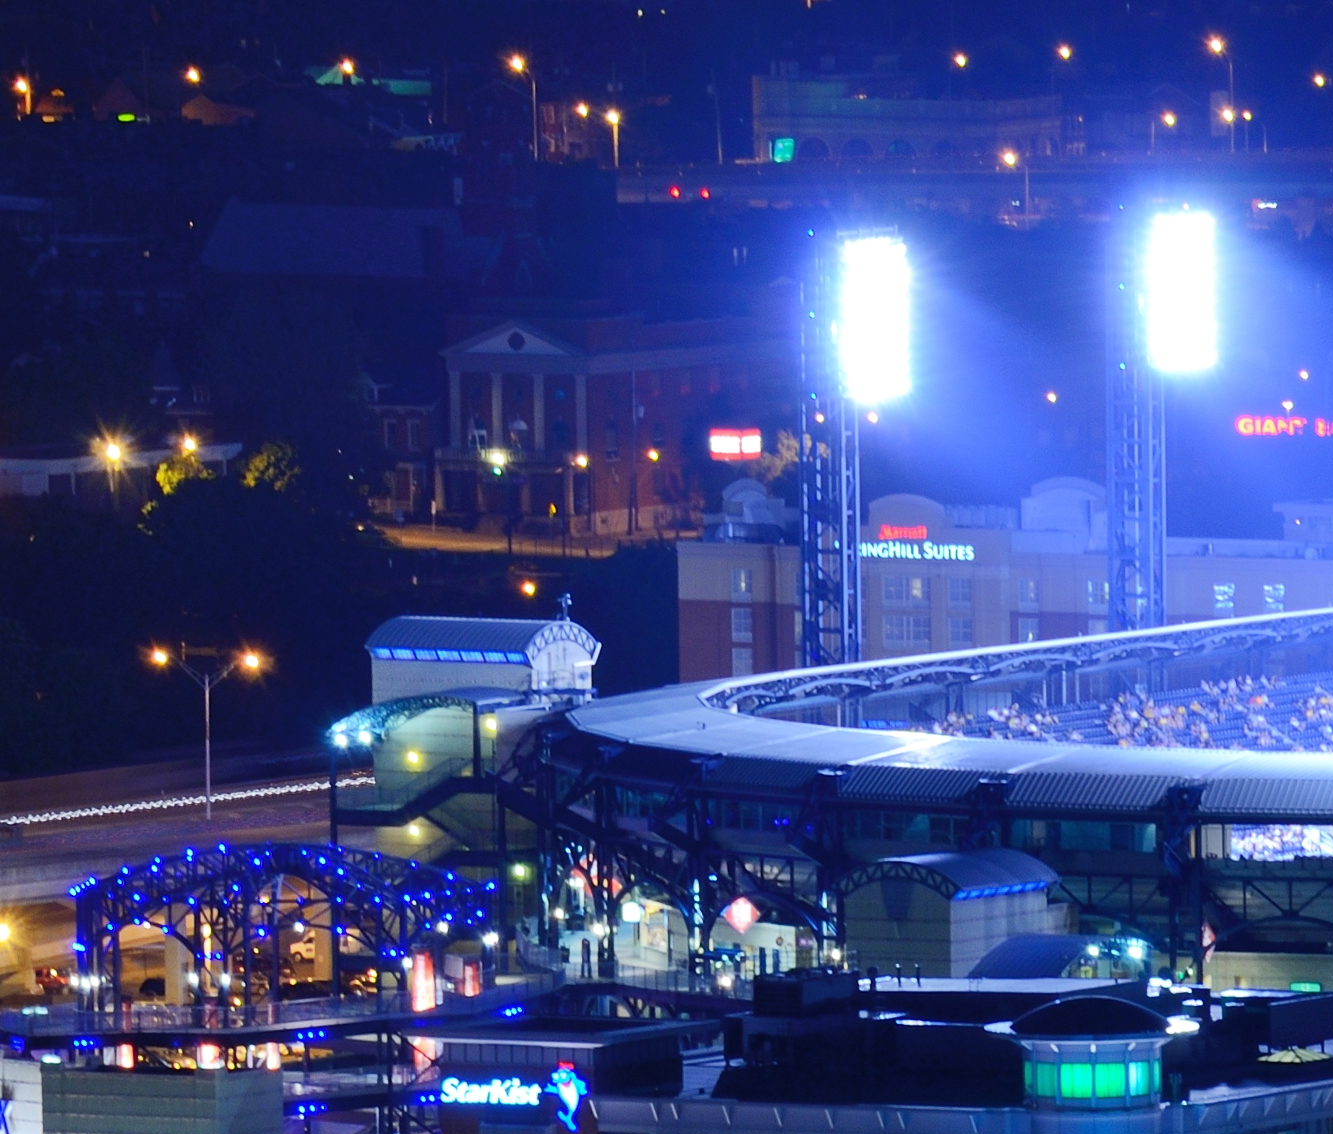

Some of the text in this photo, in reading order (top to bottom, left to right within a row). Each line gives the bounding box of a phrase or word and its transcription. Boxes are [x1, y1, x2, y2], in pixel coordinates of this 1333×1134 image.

[1236, 415, 1307, 436] GIANT
[922, 540, 975, 561] SUITES
[440, 1077, 542, 1106] StarKist
